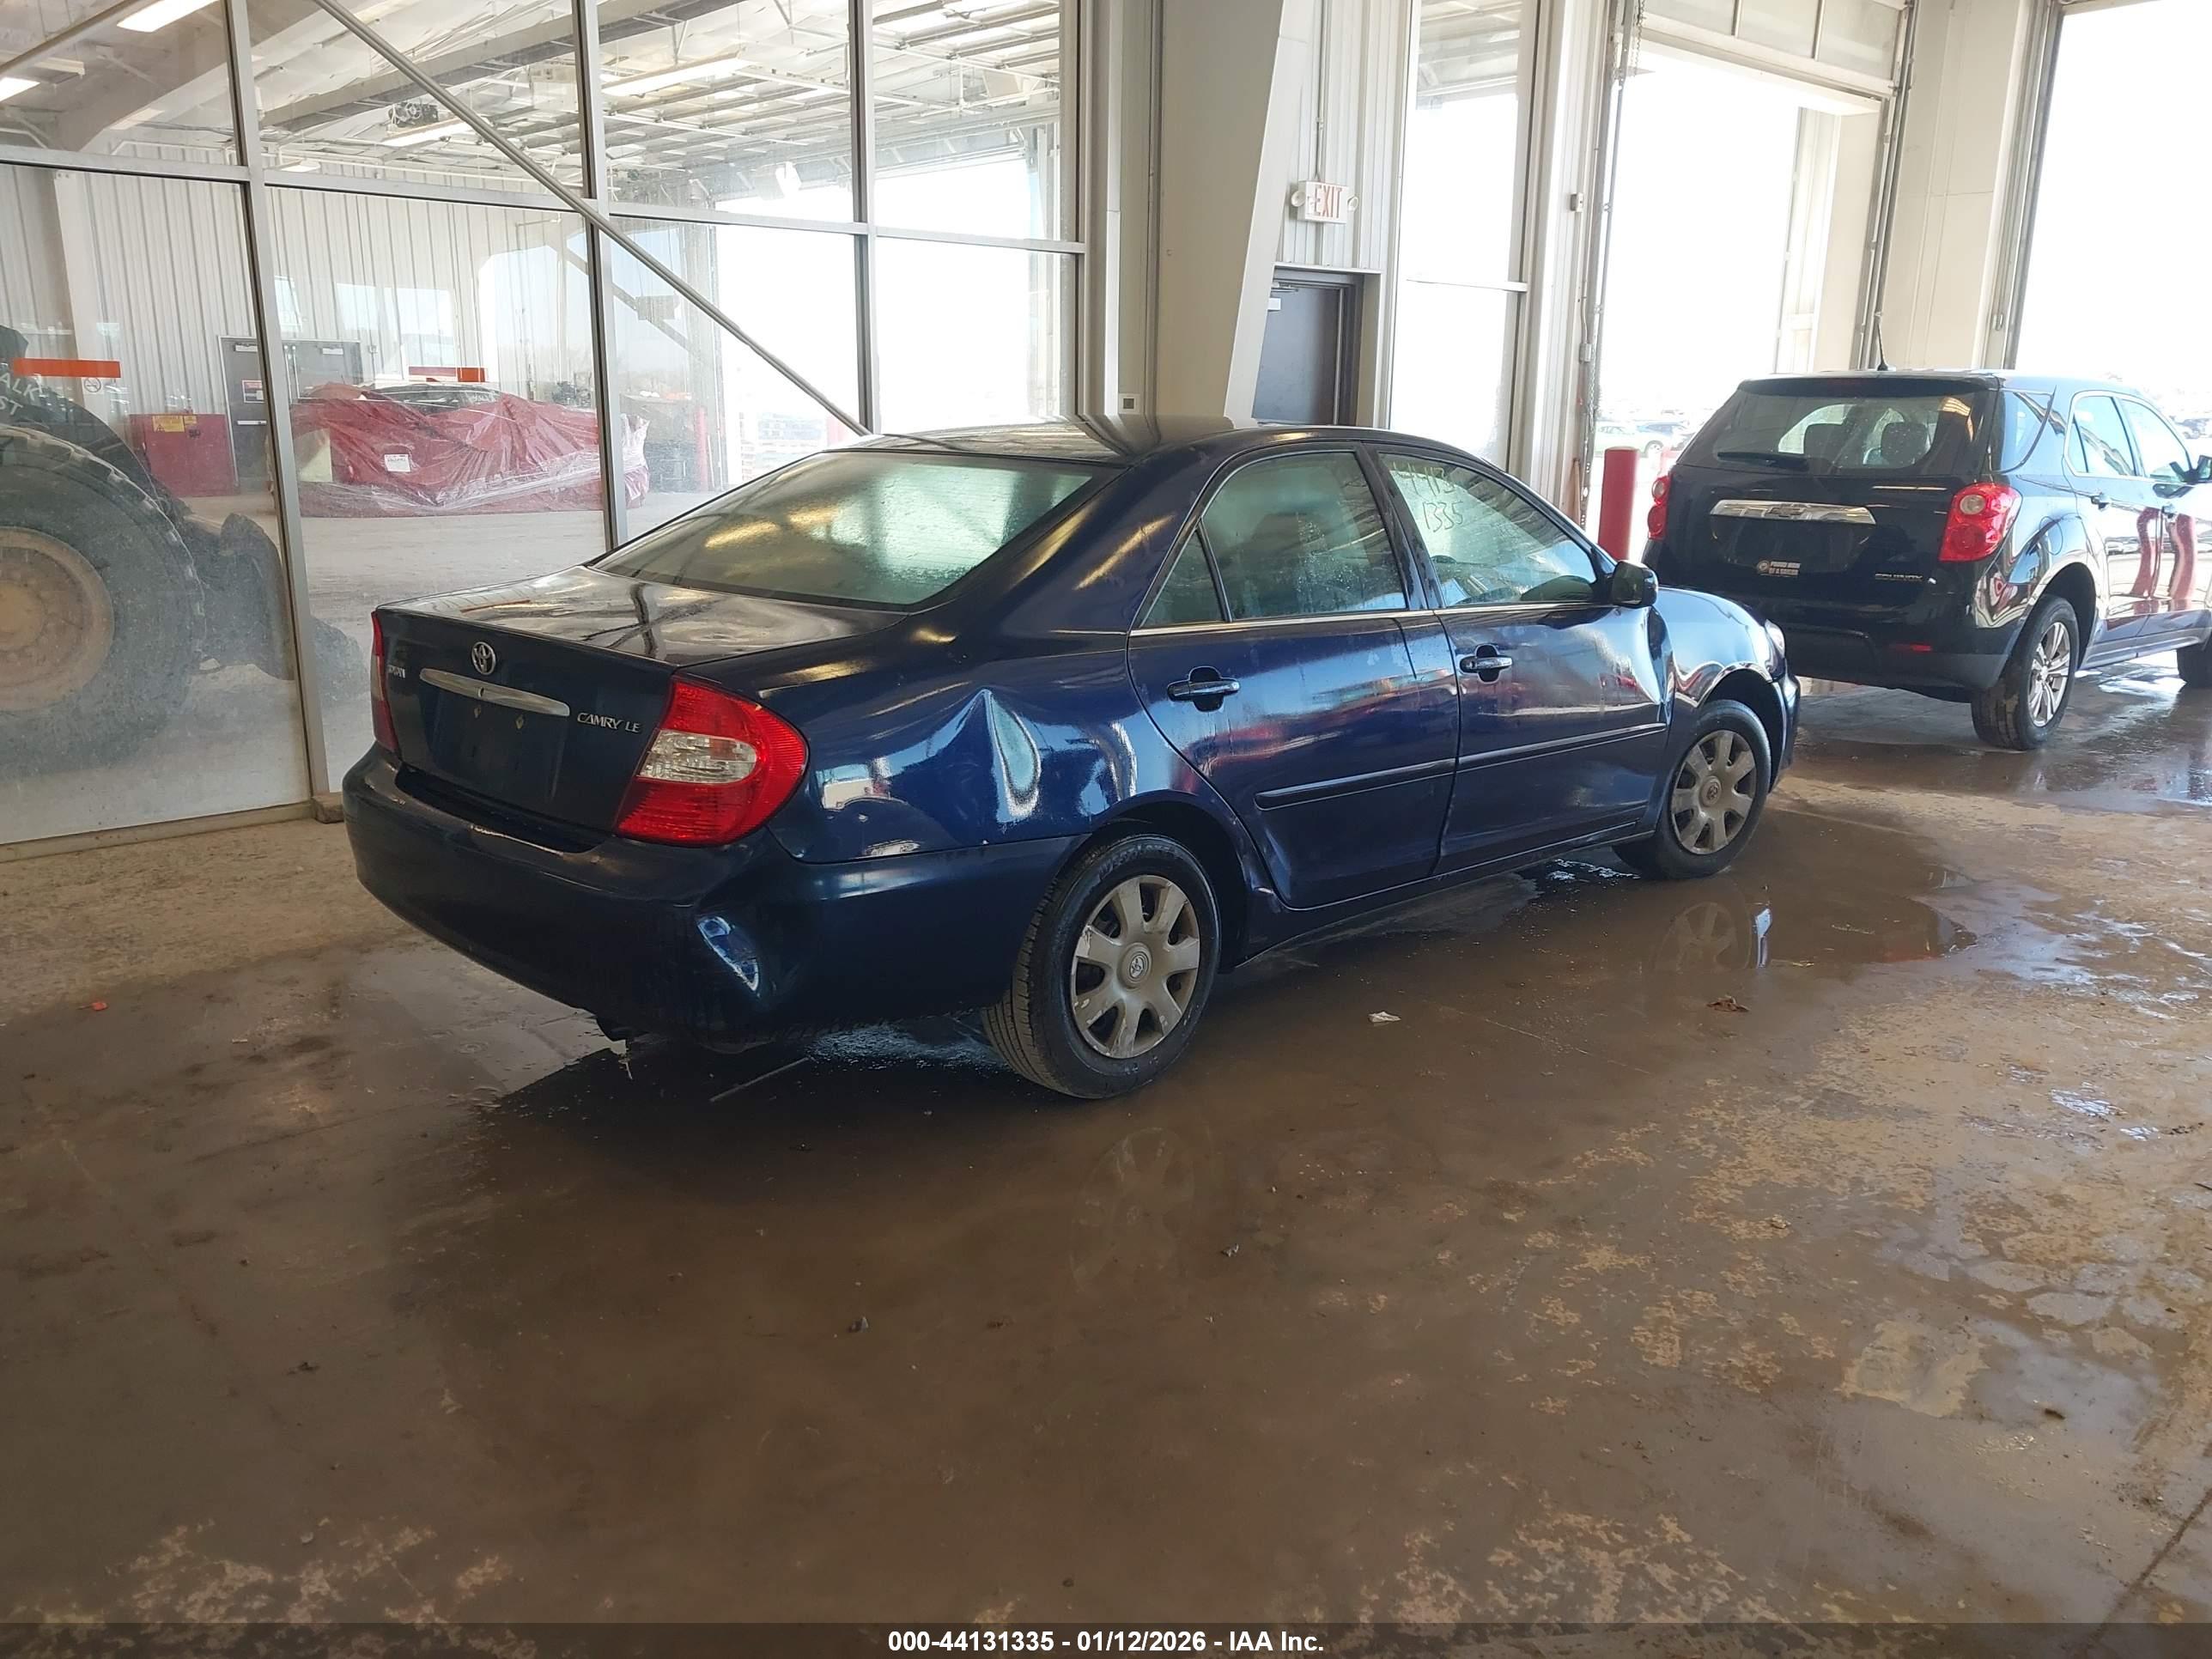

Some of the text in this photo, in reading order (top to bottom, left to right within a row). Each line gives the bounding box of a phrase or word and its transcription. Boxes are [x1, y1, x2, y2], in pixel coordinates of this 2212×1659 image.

[1314, 184, 1342, 218] EXIT
[1422, 500, 1464, 533] 1335
[577, 712, 641, 733] CAMRY LE
